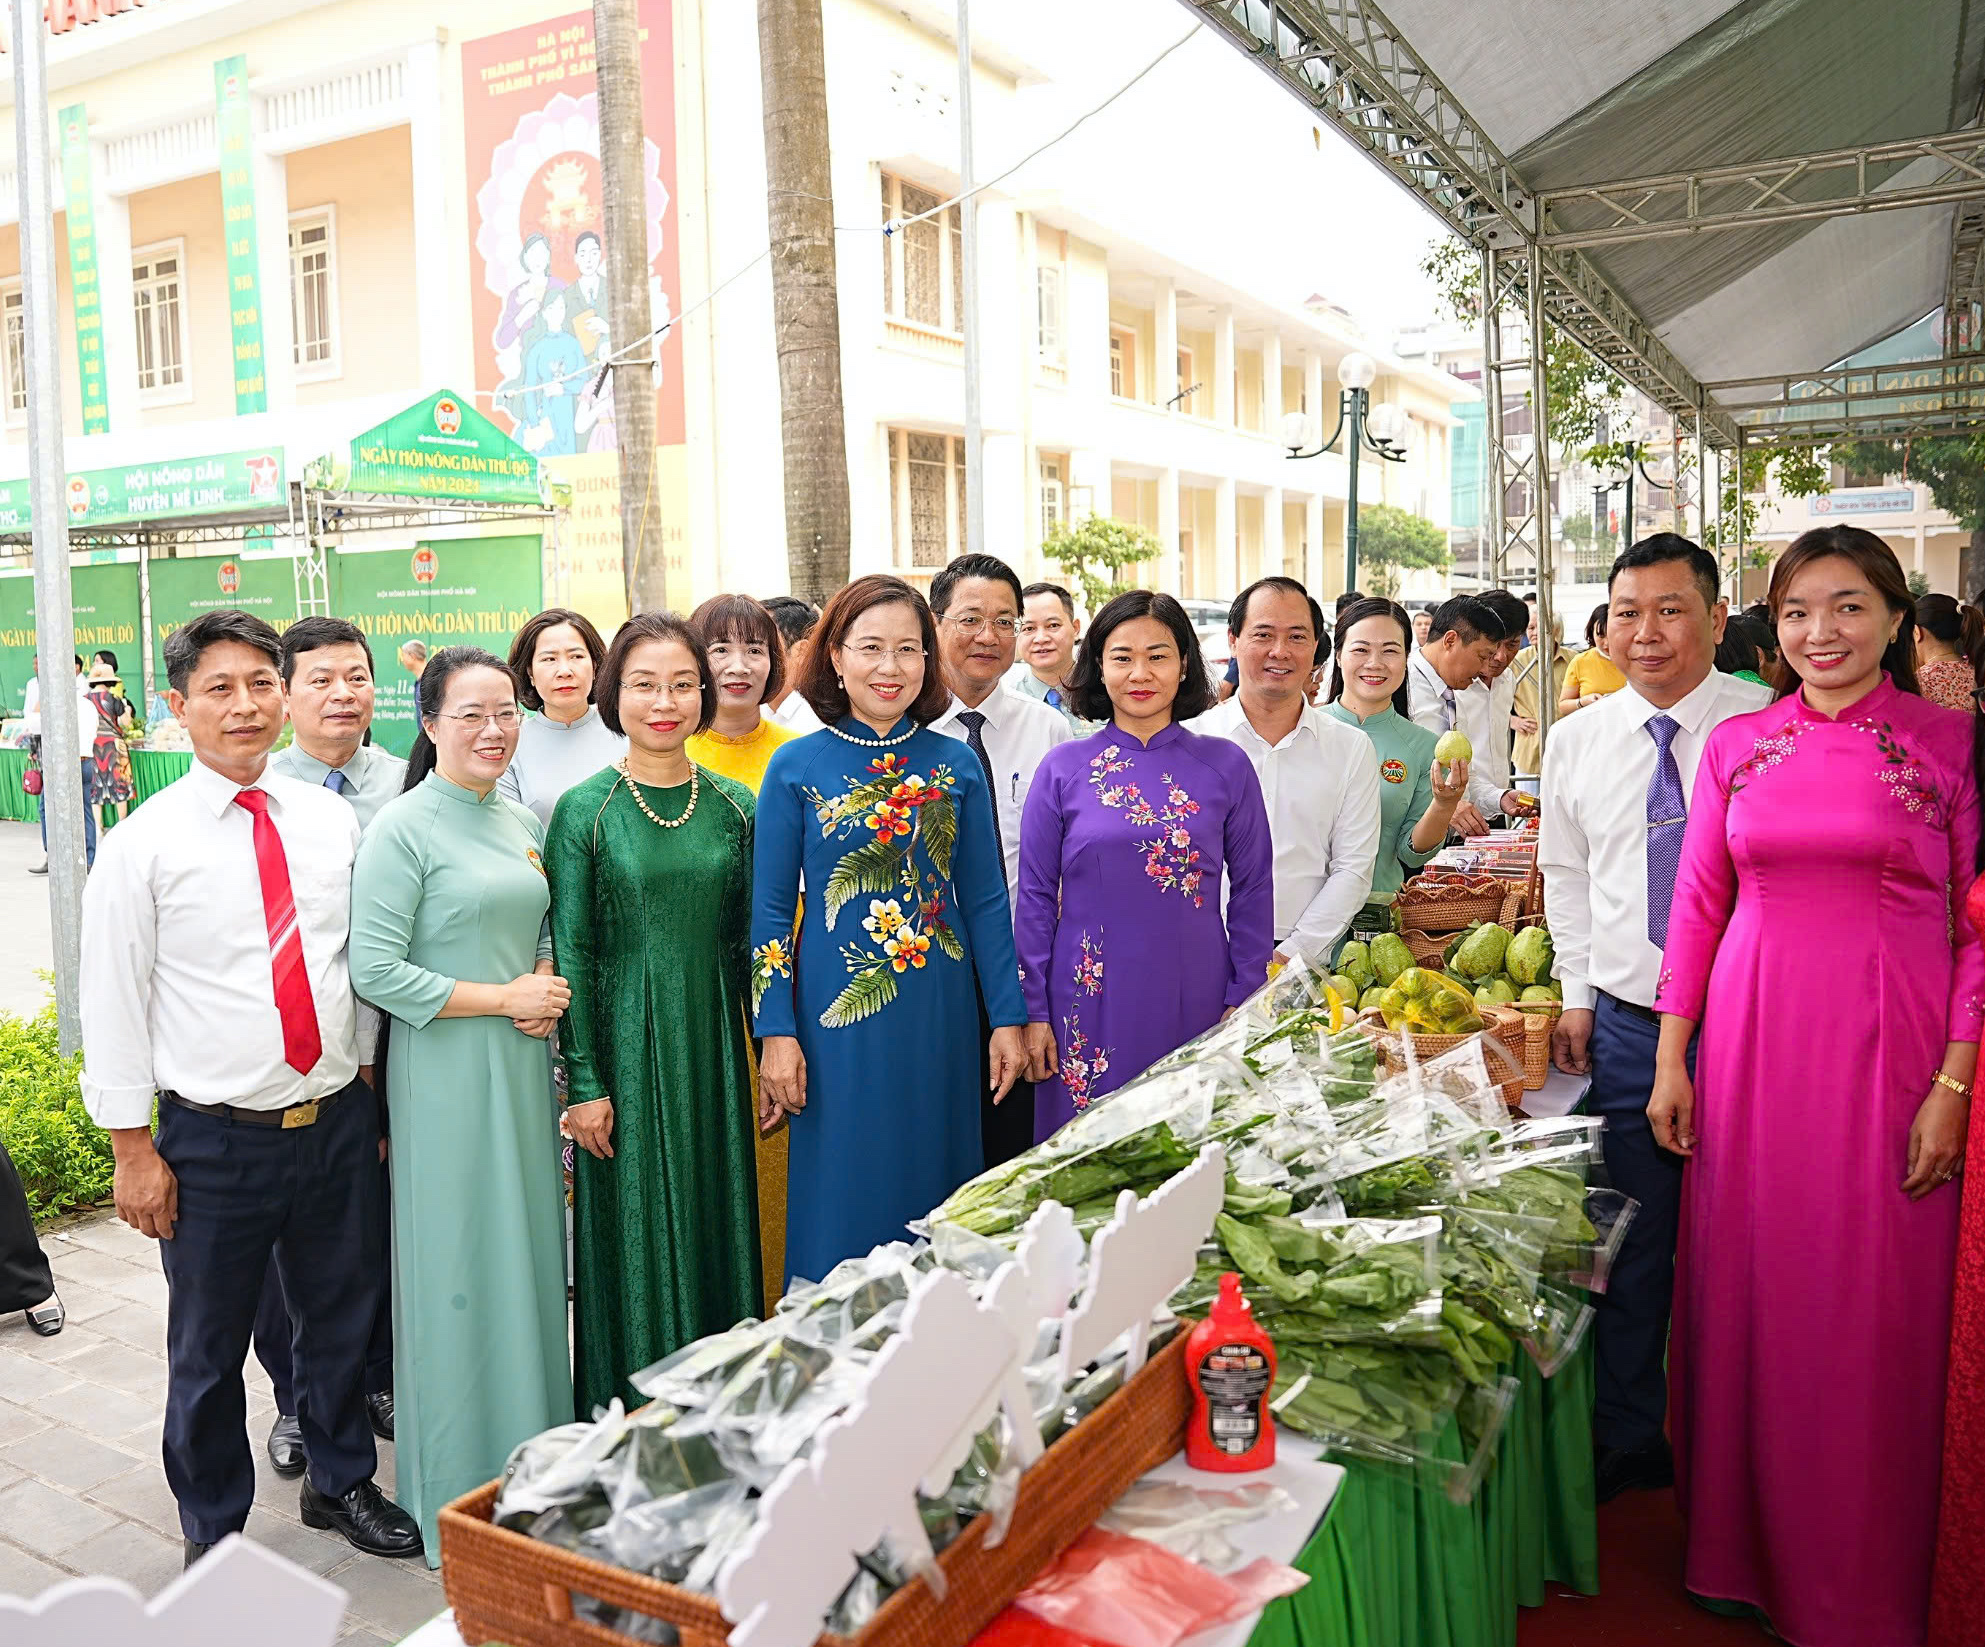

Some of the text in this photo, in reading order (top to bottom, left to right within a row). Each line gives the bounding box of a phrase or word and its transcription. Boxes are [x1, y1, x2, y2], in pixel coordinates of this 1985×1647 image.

[360, 446, 396, 465] NGÀY
[398, 448, 423, 469] HỘI
[424, 451, 460, 470] NÔNG
[462, 455, 487, 473] DÂN
[126, 460, 225, 492] HỘI NÔNG DÂN
[128, 490, 169, 514] HUYỆN
[194, 486, 225, 506] LINH
[75, 623, 95, 645] DÂN
[96, 620, 117, 645] THỦ
[376, 609, 401, 638] HỘI
[401, 609, 441, 635] NÔNG
[445, 606, 475, 634] DÂN
[475, 603, 506, 633] THỦ
